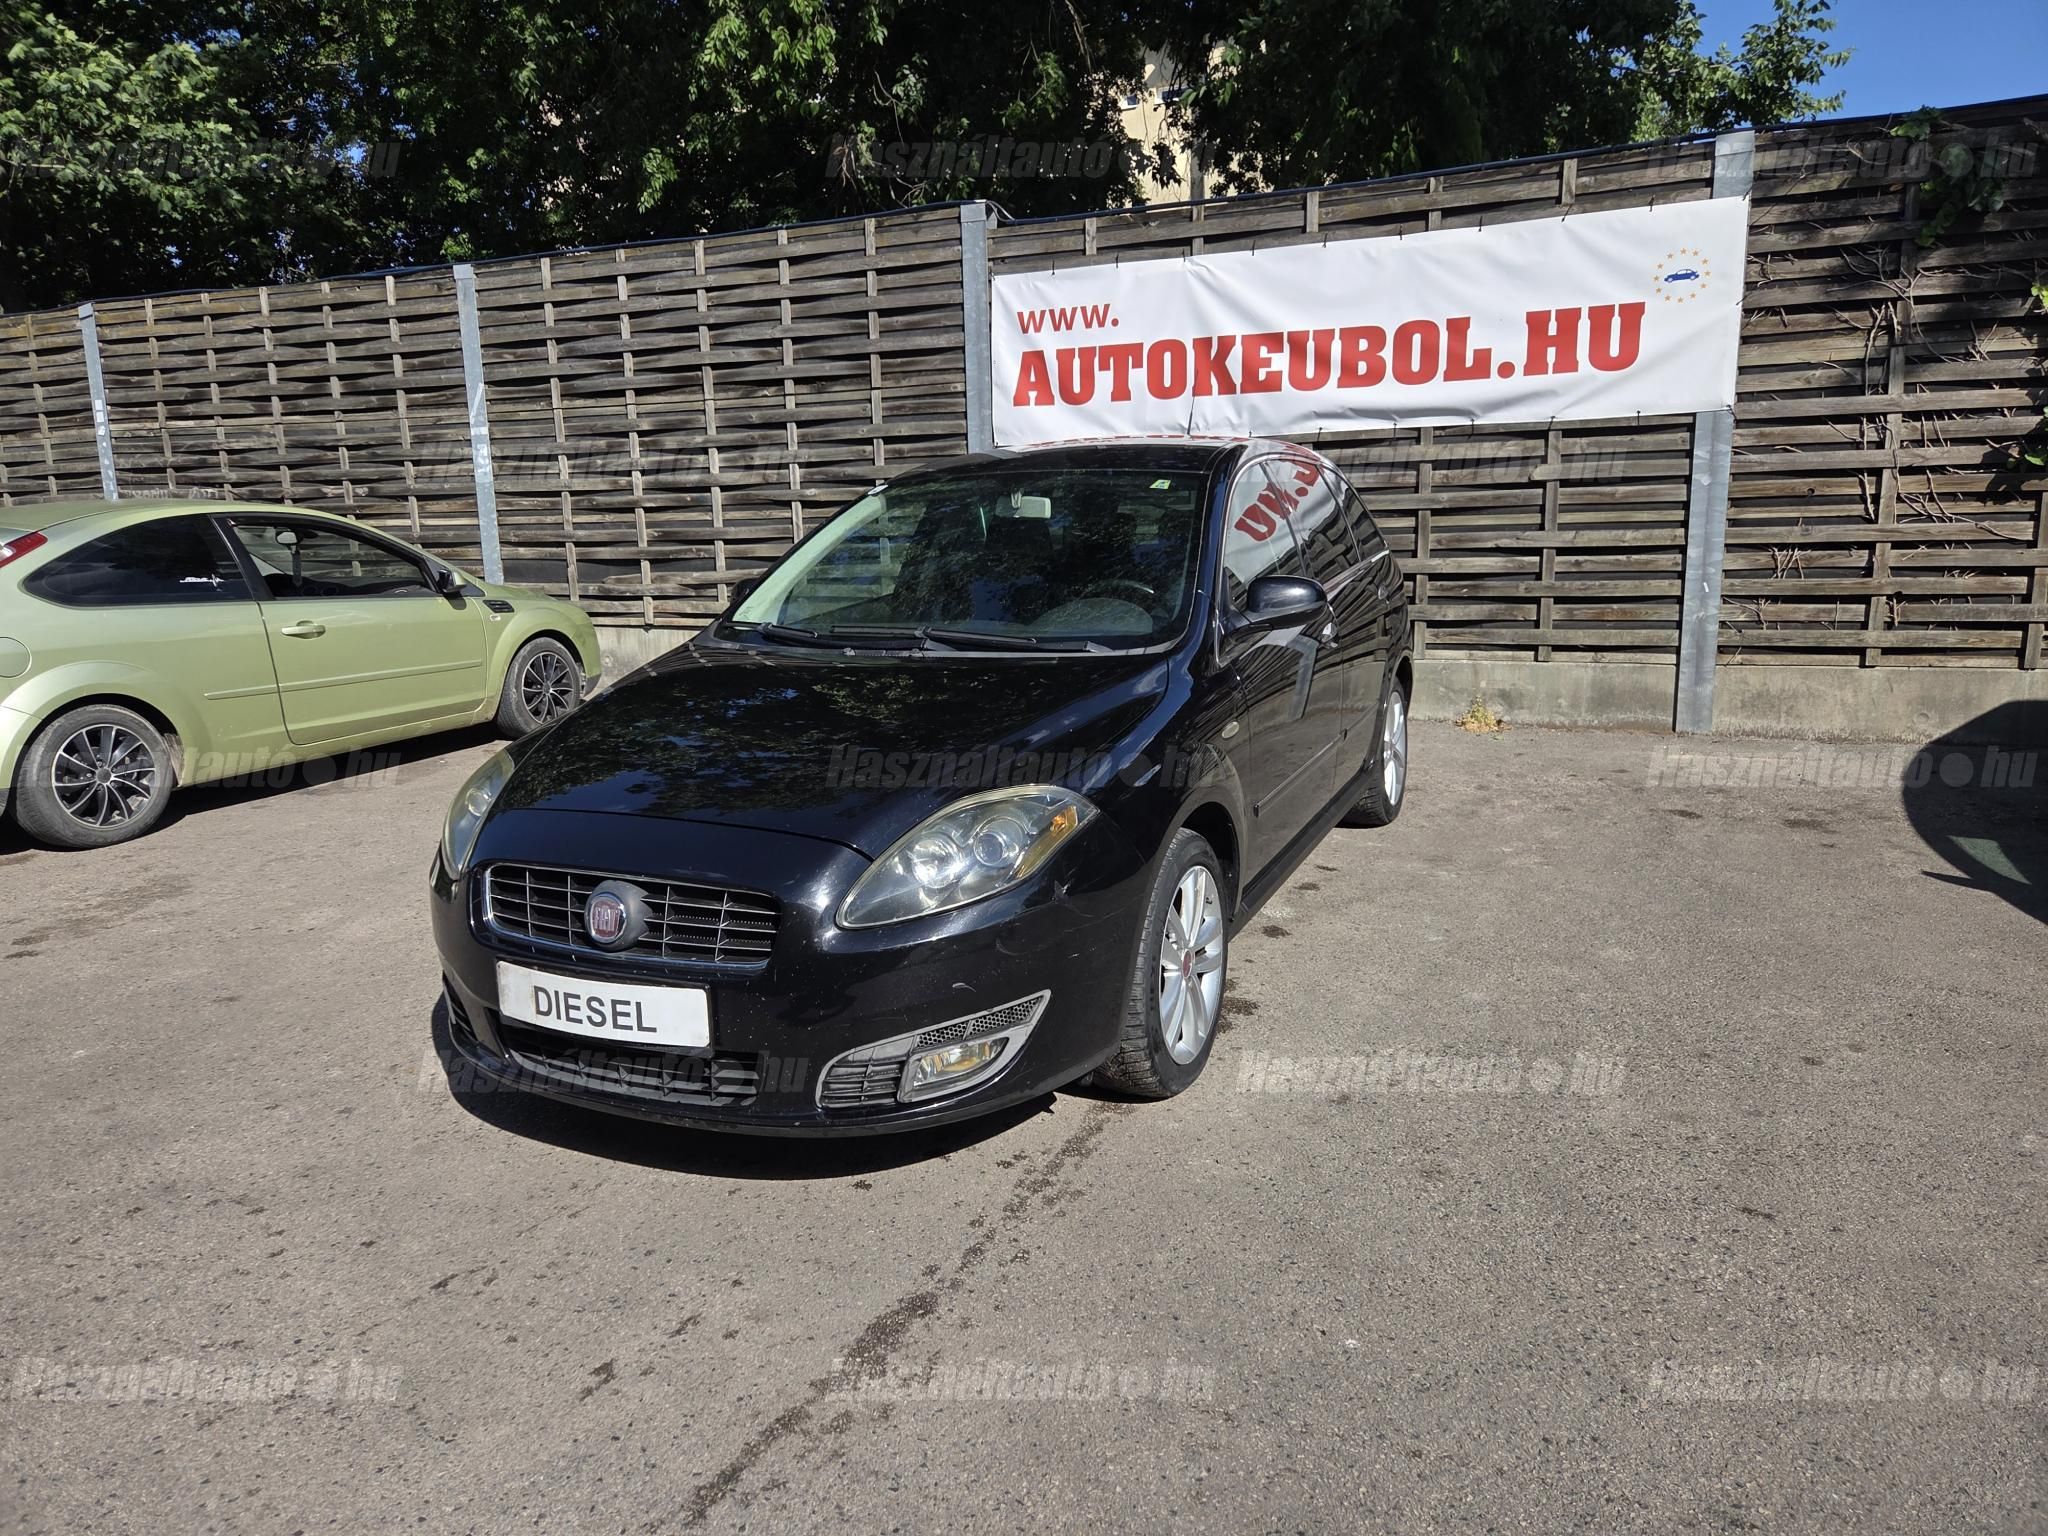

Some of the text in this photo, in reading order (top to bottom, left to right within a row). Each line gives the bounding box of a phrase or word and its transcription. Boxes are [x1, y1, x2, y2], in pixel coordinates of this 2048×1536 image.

[1016, 303, 1120, 335] www.
[1012, 301, 1646, 407] AUTOKEUBOL.HU
[533, 985, 657, 1033] DIESEL
